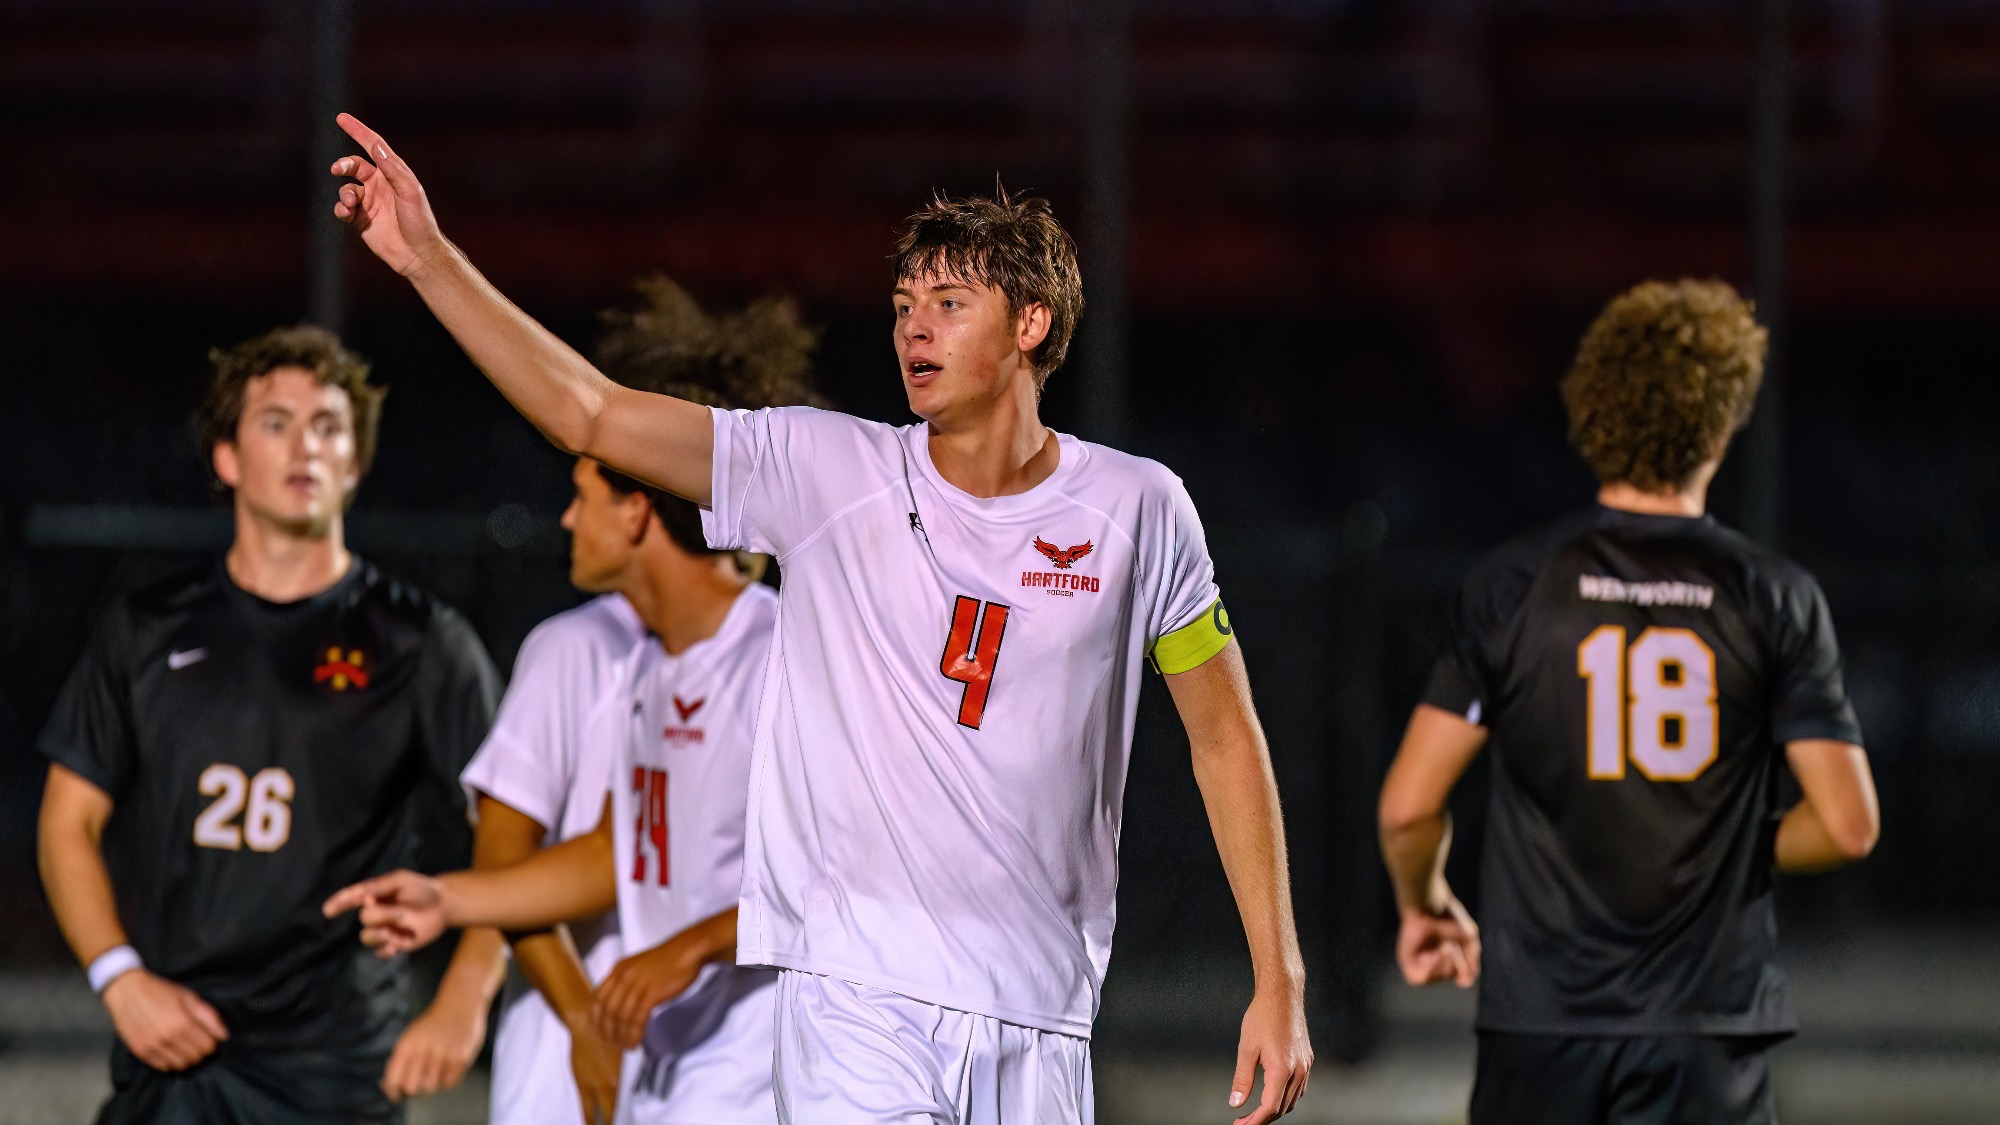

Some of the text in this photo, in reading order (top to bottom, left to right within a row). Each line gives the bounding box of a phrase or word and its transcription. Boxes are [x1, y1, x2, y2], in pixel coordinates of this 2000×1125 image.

[1021, 571, 1100, 593] HARTFORD
[940, 594, 1010, 731] 4
[1577, 624, 1720, 782] 18
[193, 761, 295, 852] 26
